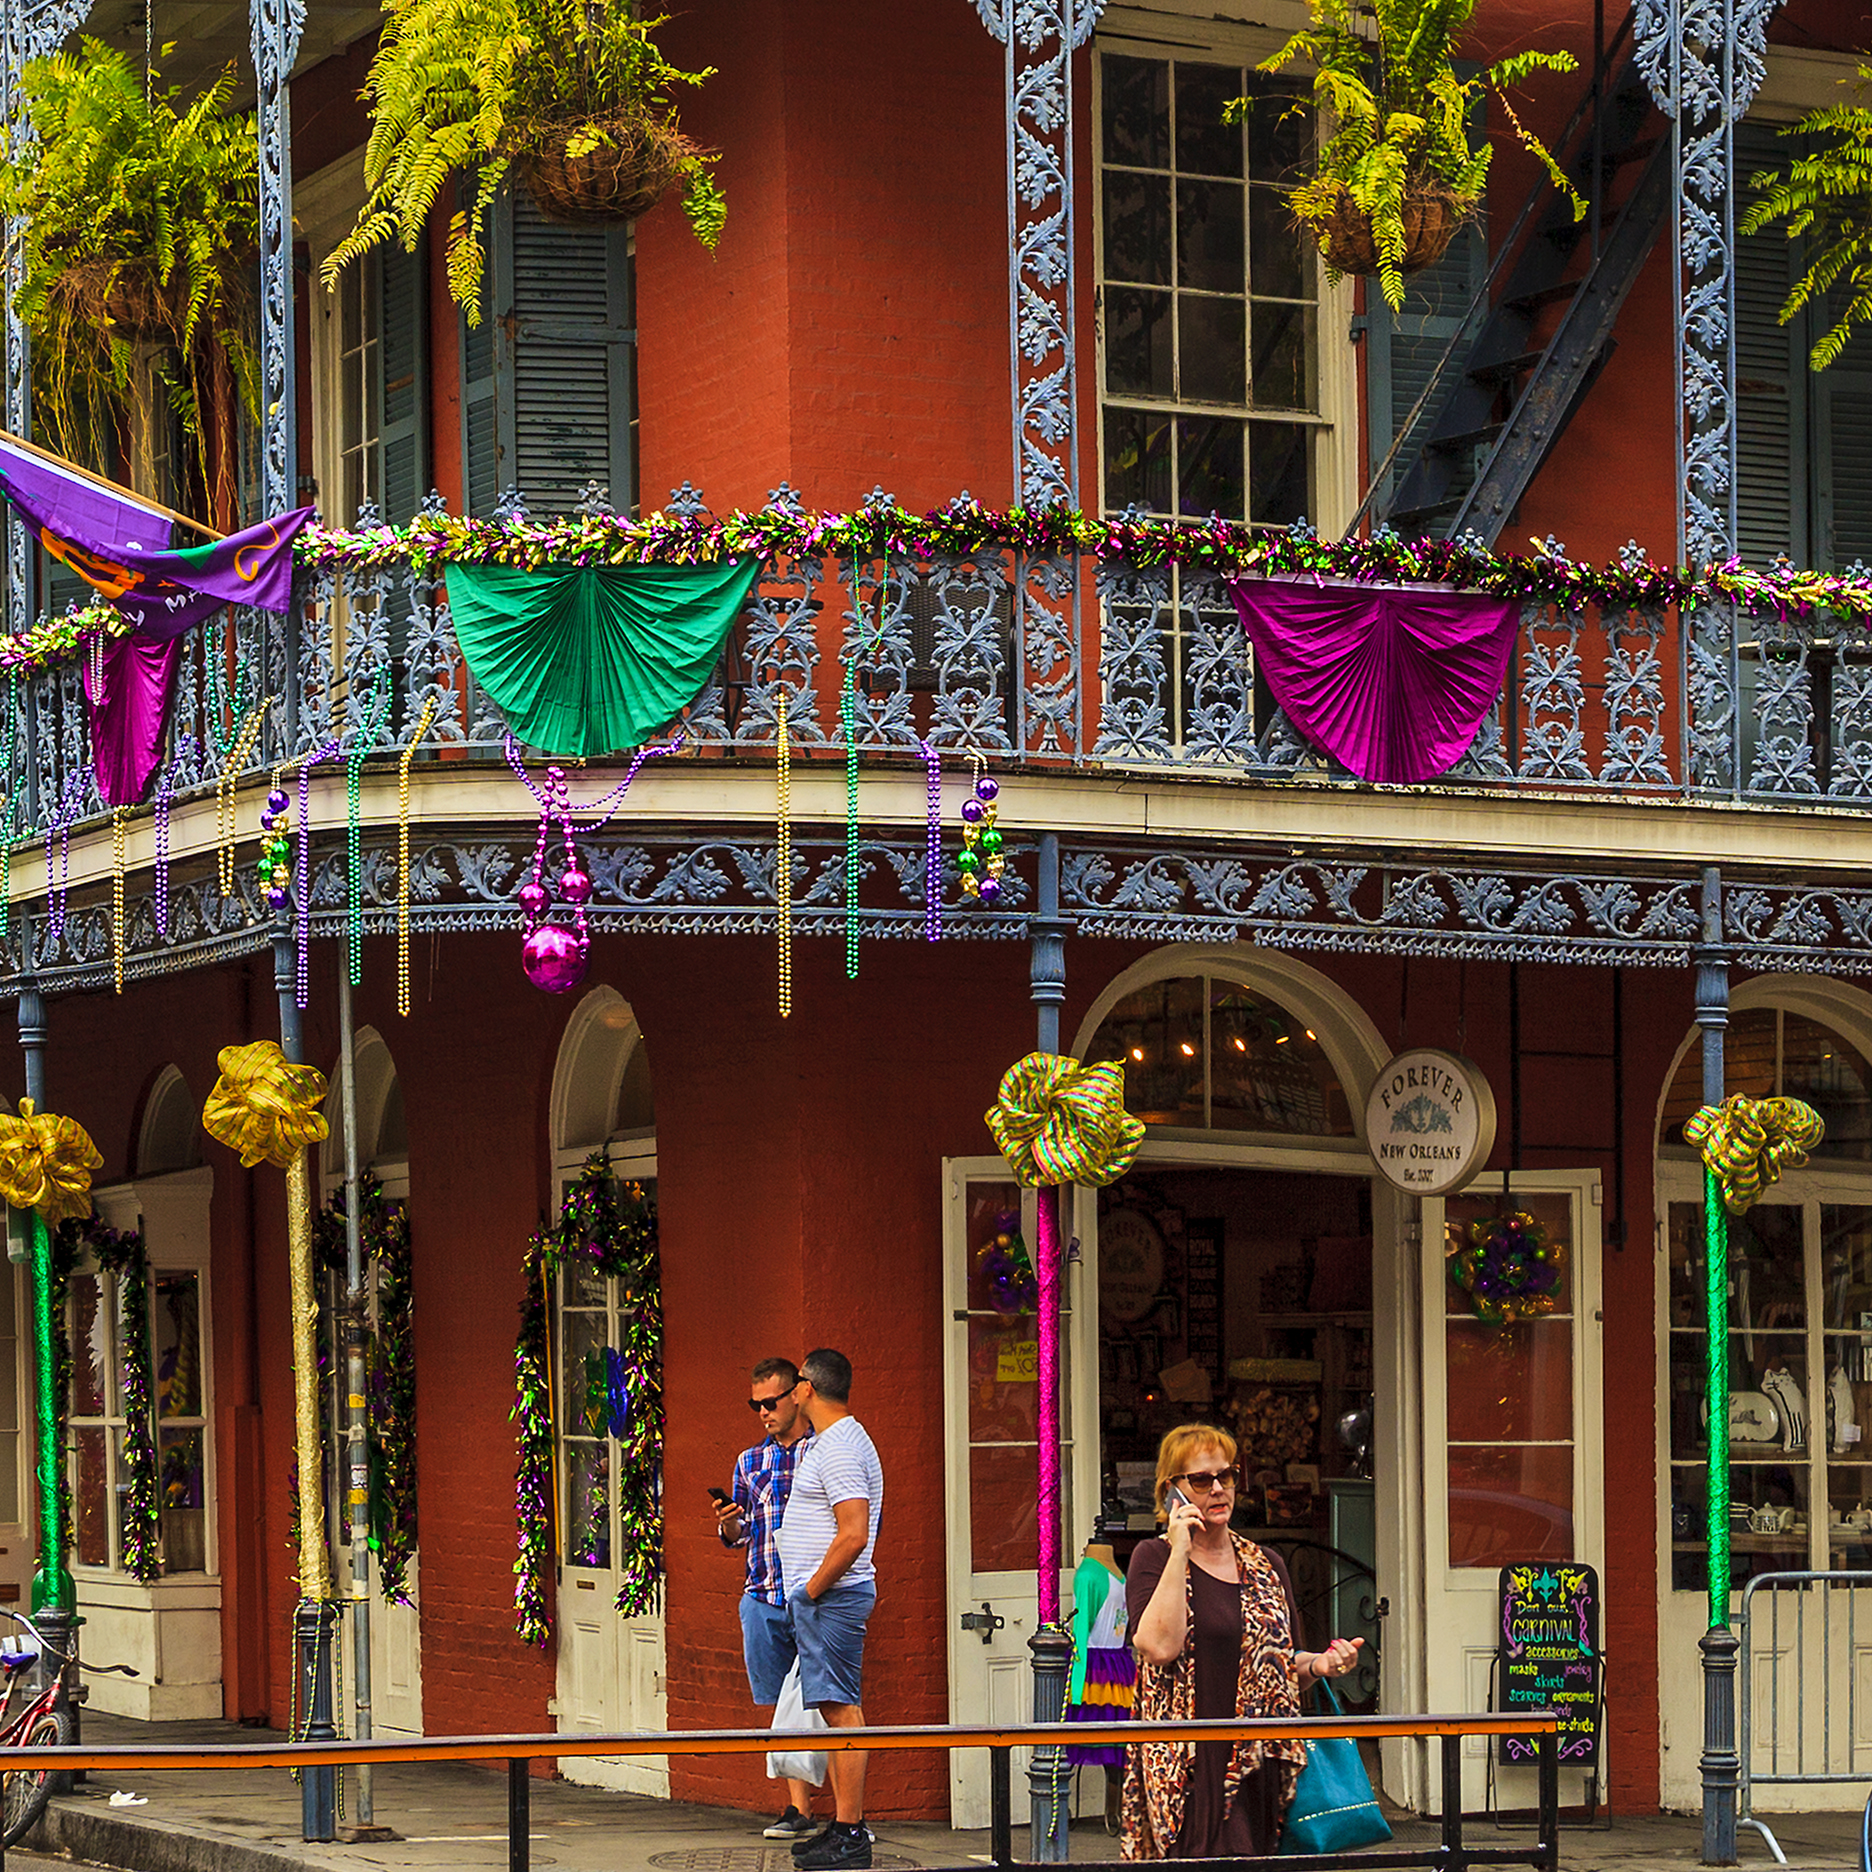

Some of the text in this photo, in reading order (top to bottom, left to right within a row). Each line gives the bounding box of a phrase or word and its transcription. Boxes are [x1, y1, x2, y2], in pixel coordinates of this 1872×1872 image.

[1381, 1065, 1464, 1114] FOREVER
[1380, 1143, 1461, 1160] NEW ORLEANS
[1515, 1600, 1540, 1615] Don
[1509, 1661, 1539, 1676] masks
